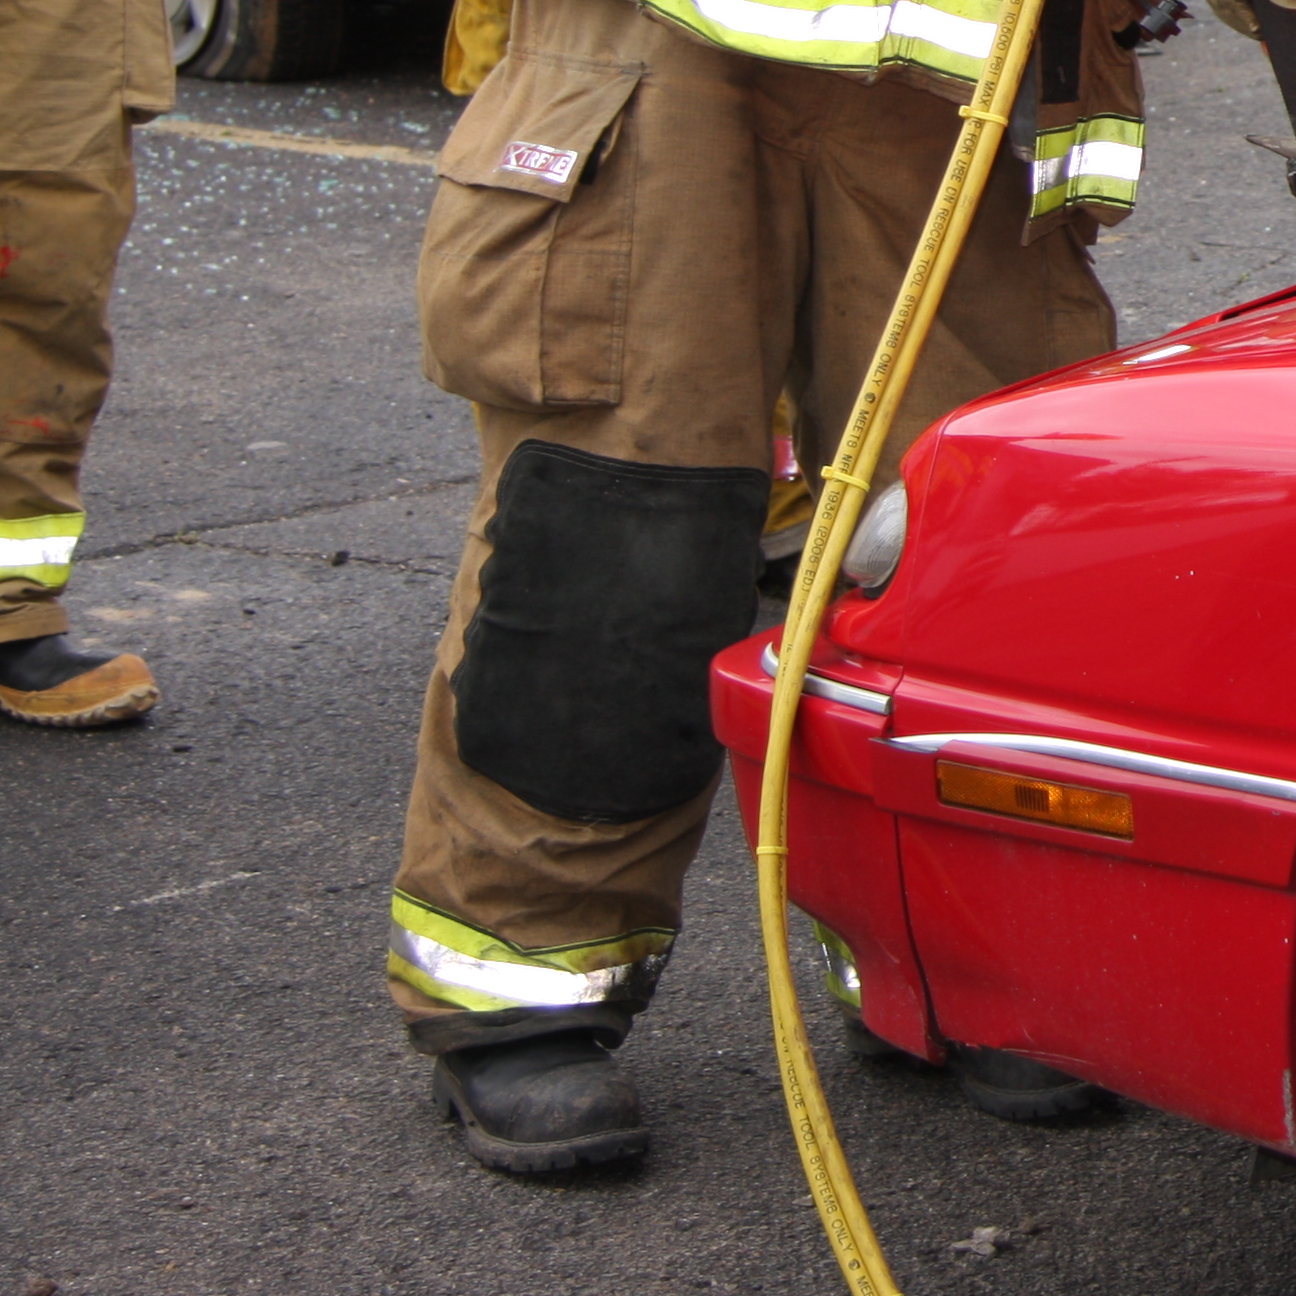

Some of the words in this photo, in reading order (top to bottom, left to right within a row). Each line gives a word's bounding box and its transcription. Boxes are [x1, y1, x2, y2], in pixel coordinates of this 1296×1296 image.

[909, 258, 931, 288] TOOL
[872, 352, 892, 388] ONLY
[799, 1116, 818, 1151] TOOL
[831, 1219, 854, 1252] ONLY
